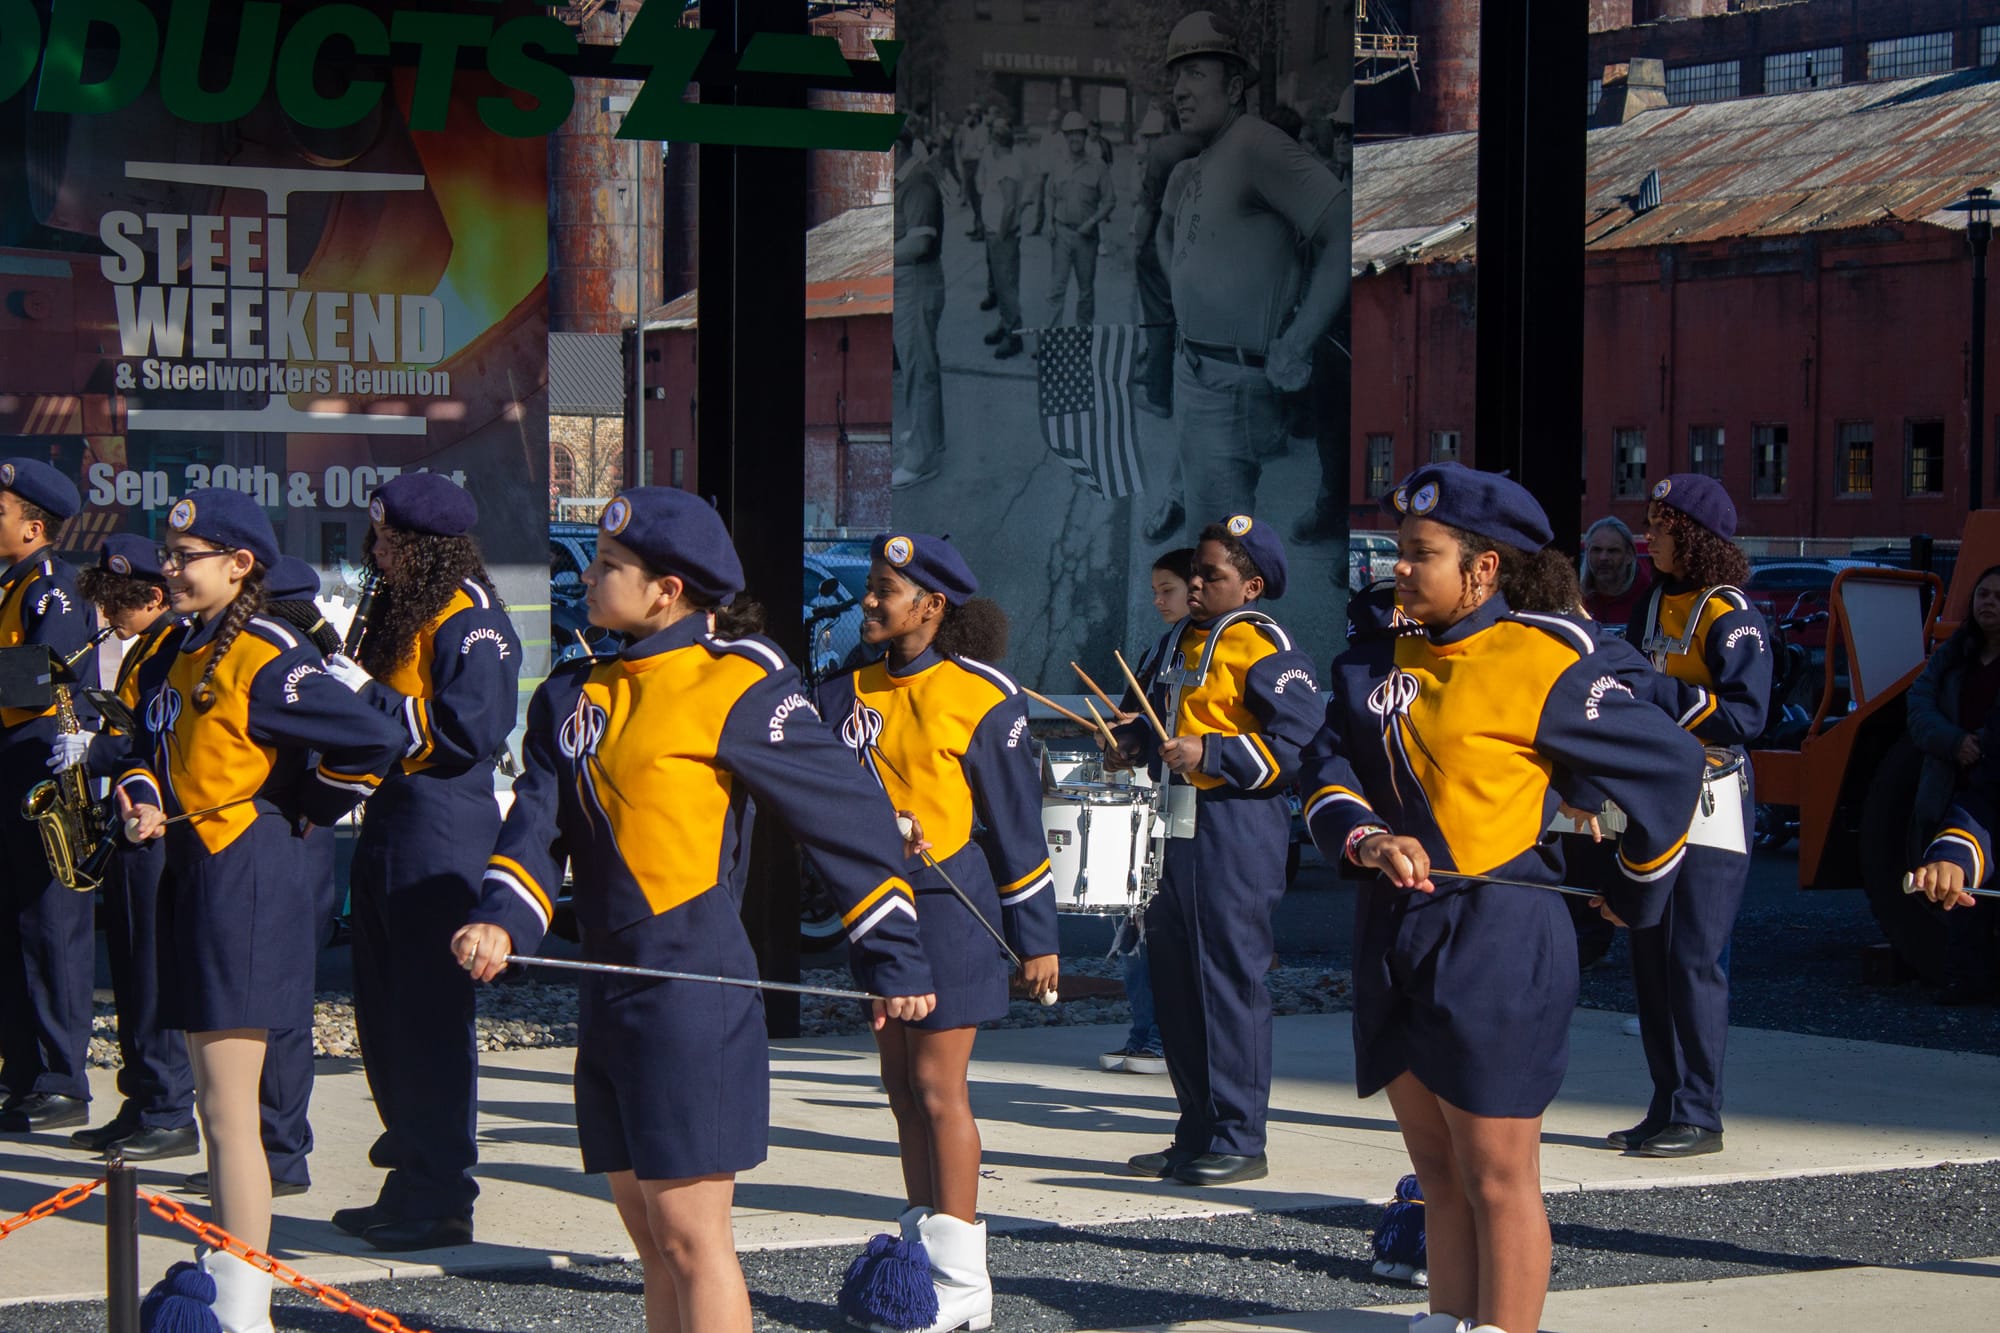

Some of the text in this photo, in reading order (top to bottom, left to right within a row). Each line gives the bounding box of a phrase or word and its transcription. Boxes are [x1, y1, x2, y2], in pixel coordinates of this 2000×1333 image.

[99, 210, 299, 289] STEEL
[113, 285, 446, 365] WEEKEND
[115, 358, 451, 396] & Steelworkers Reunion
[88, 463, 178, 510] Sep.
[287, 471, 317, 508] &
[461, 628, 510, 660] BROUGHAL
[284, 664, 326, 704] BROUG
[1274, 669, 1317, 694] BROUGHAL
[1585, 675, 1635, 721] BROUGH
[768, 693, 823, 743] BROUGH
